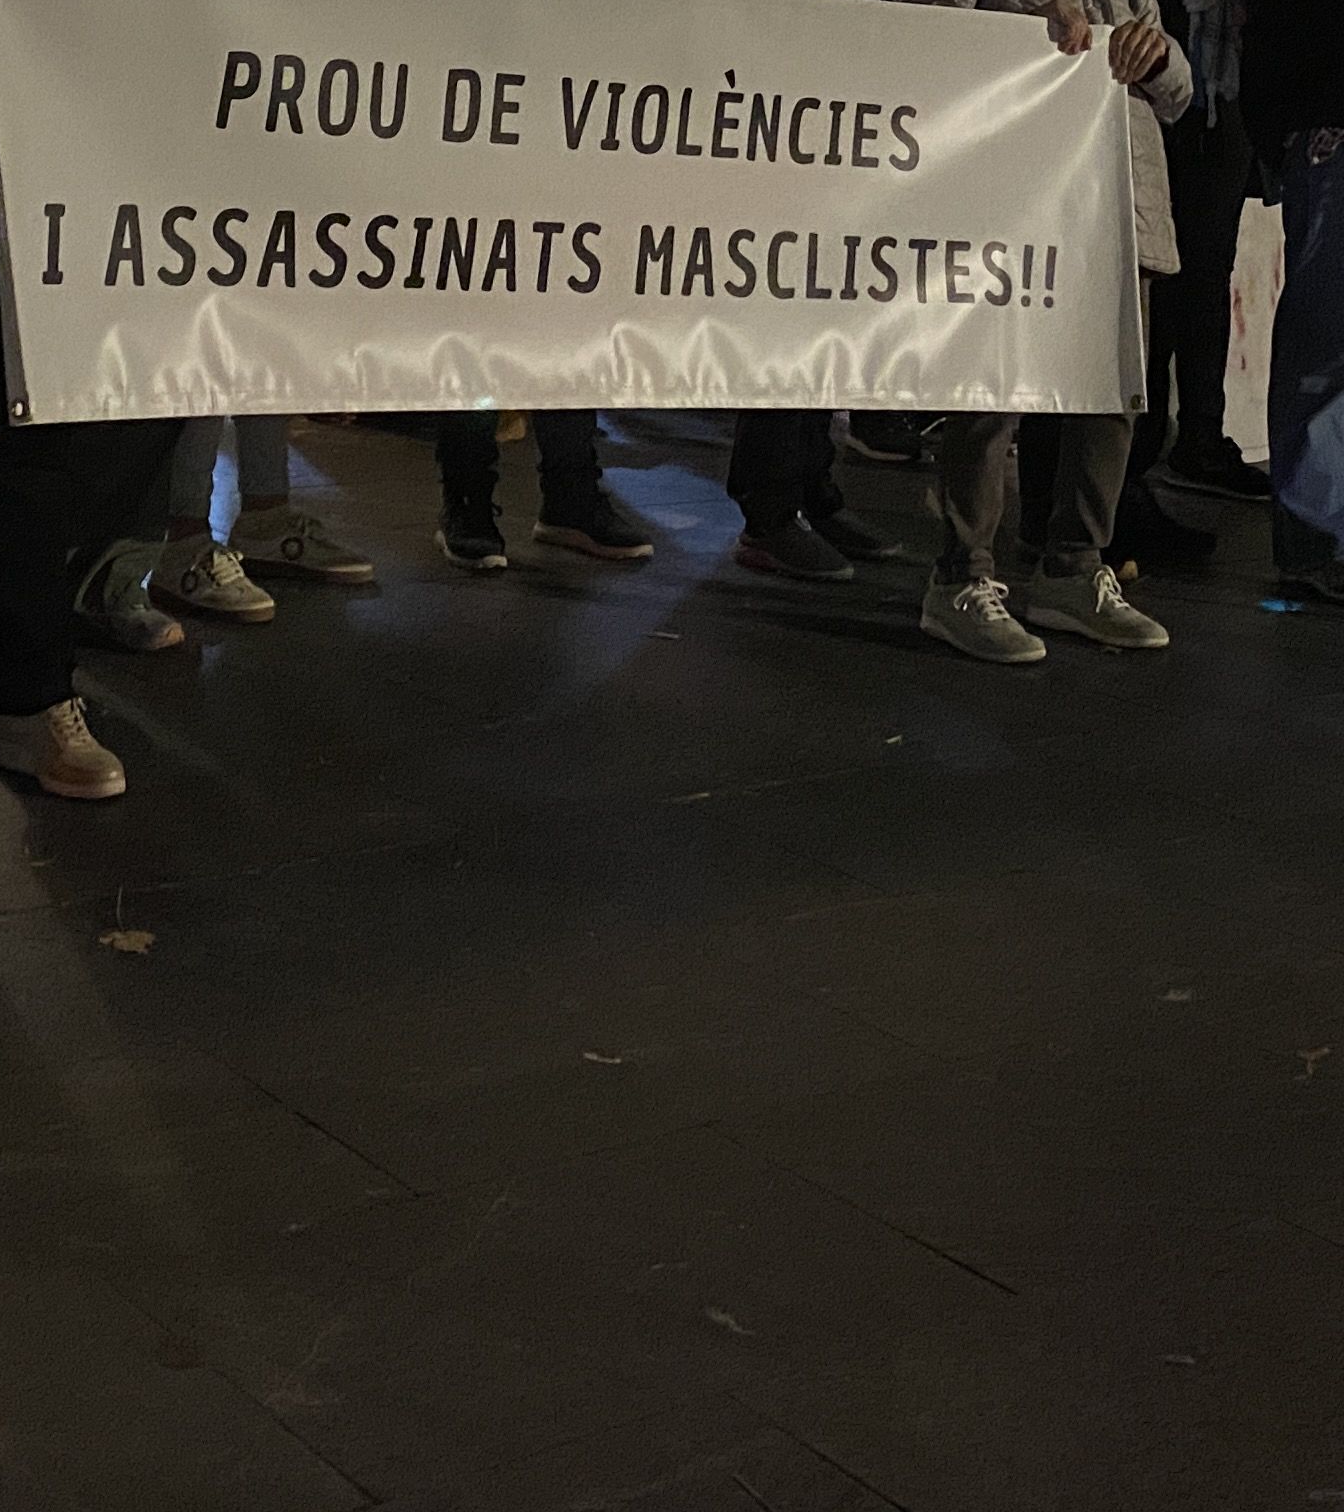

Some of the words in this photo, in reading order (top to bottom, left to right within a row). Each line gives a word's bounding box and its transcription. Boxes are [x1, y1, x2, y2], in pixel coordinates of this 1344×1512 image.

[216, 50, 409, 139] PROU
[442, 68, 526, 145] DE
[561, 69, 920, 172] VIOLÈNCIES
[41, 203, 66, 285] I
[104, 204, 602, 294] ASSASSINATS
[634, 224, 1058, 308] MASCLISTES!!
